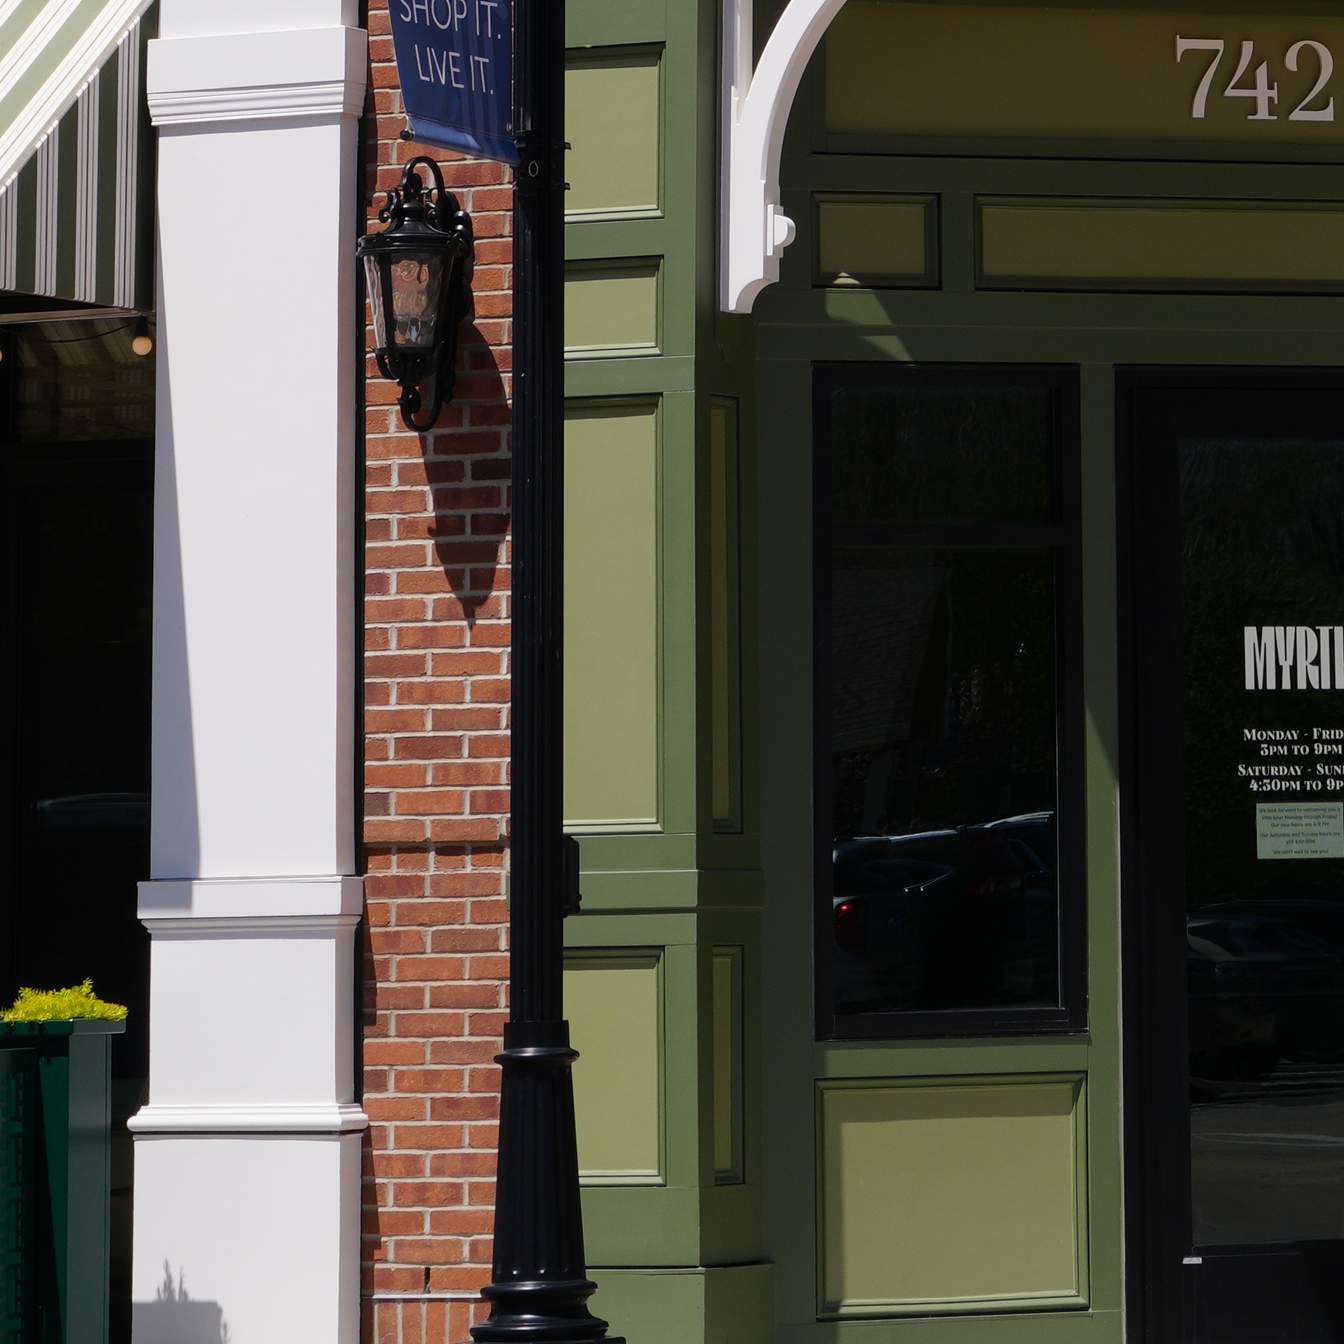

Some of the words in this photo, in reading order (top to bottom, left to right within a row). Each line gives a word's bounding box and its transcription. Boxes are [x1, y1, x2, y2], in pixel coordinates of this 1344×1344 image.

[475, 0, 501, 39] IT.
[414, 44, 465, 89] LIVE
[469, 55, 494, 95] IT.
